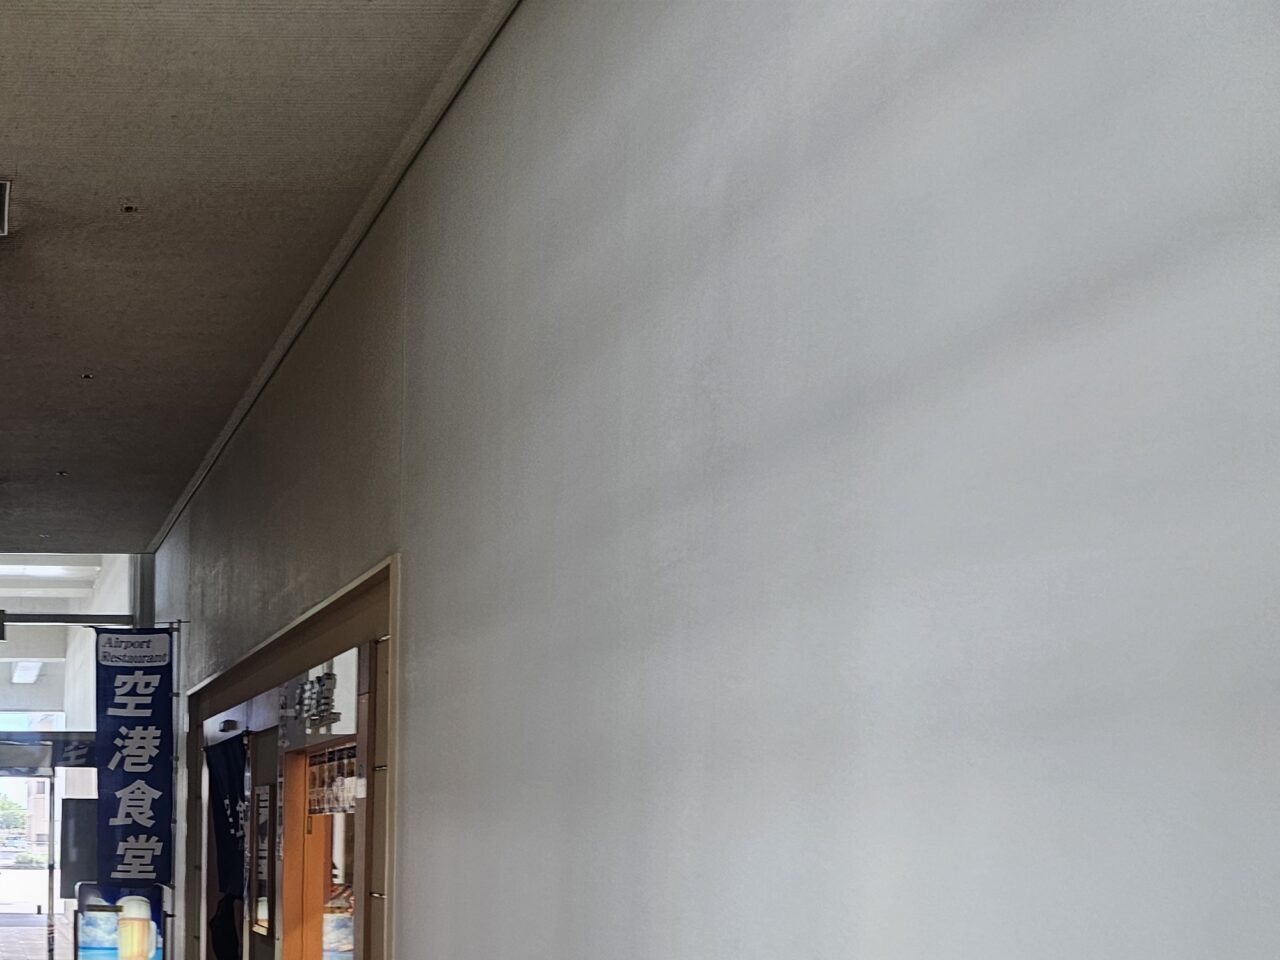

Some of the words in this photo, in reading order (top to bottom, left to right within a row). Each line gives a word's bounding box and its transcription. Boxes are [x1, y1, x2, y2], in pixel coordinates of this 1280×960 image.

[101, 637, 152, 650] Airport
[101, 651, 168, 664] Restaurant
[106, 670, 163, 880] 空港食堂
